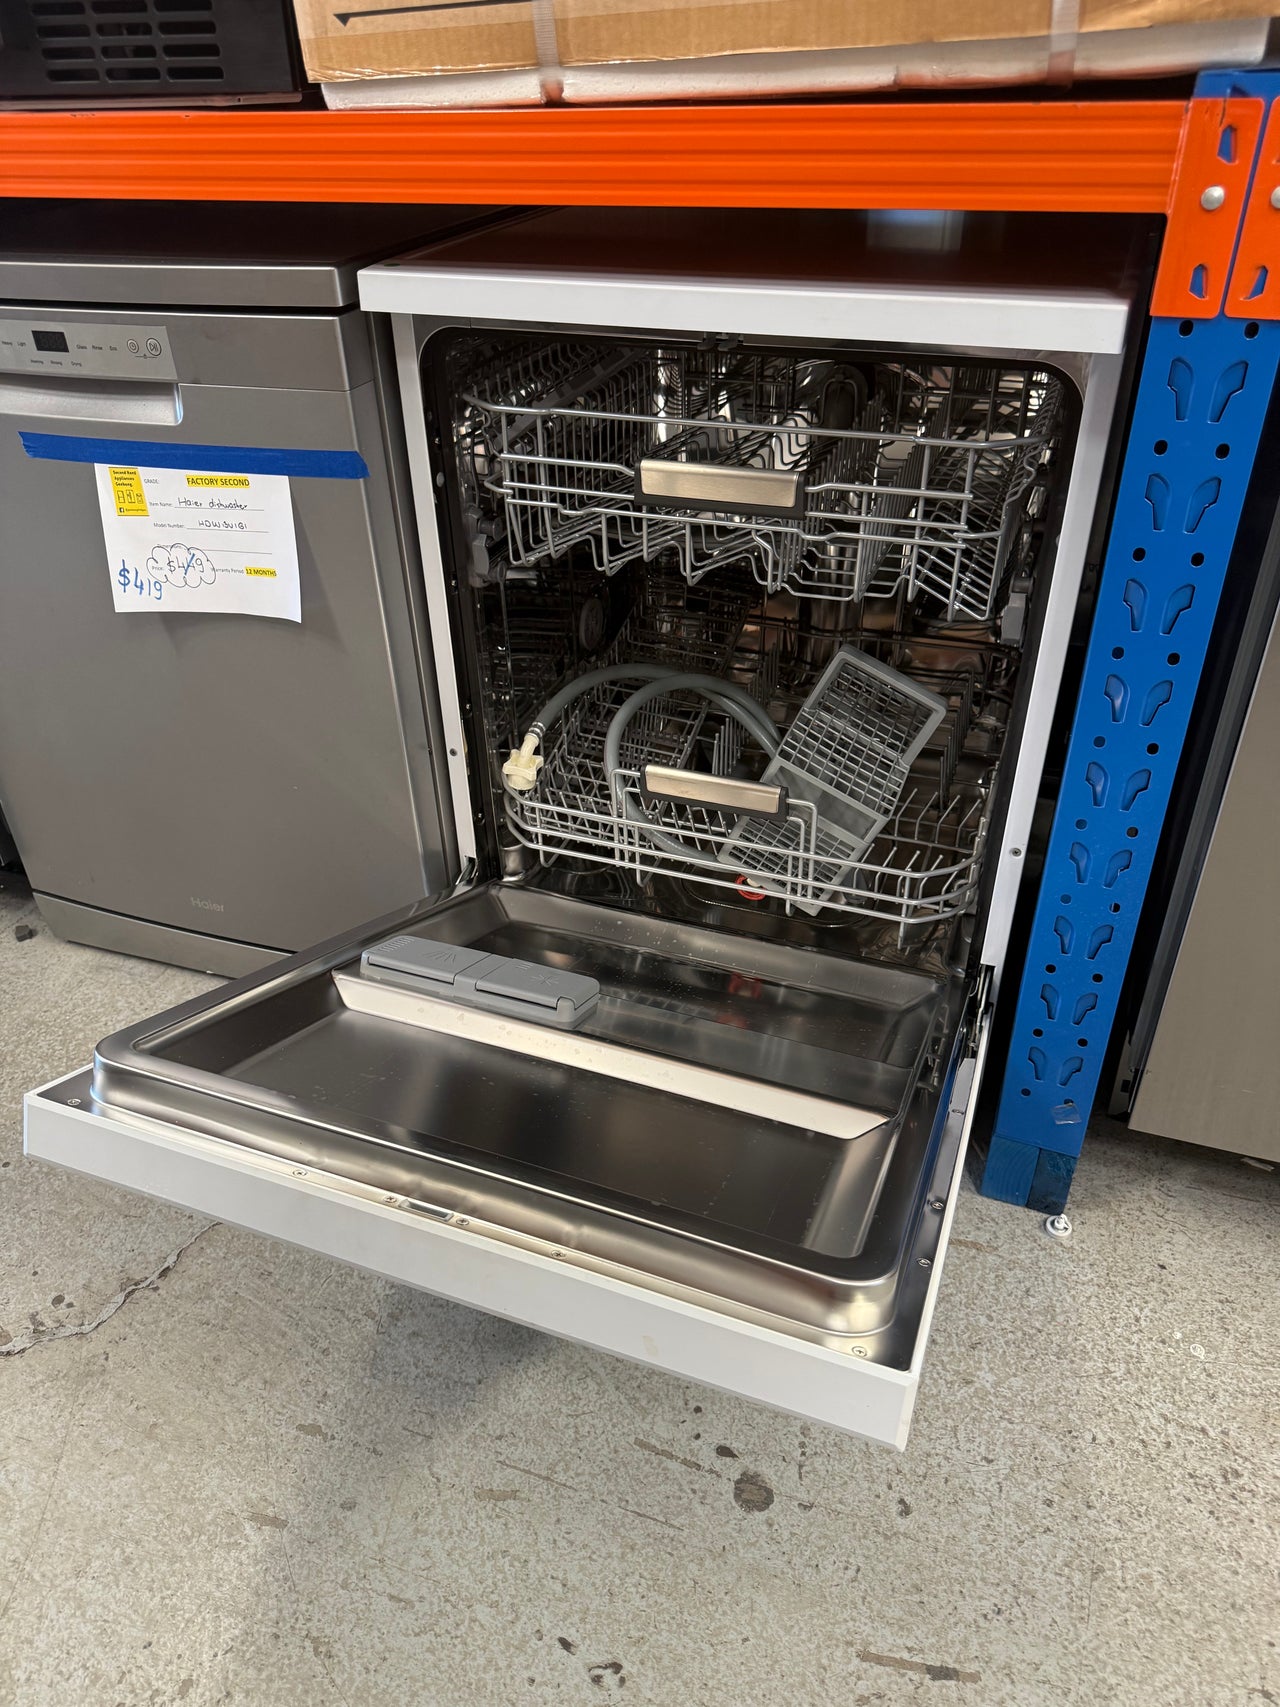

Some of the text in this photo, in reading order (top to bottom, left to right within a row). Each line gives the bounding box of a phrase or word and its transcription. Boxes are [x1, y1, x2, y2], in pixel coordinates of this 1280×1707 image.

[186, 477, 250, 487] FACTORY SECOND
[178, 497, 202, 507] Haier
[253, 569, 277, 577] MONTHS
[117, 558, 163, 601] $419
[190, 896, 224, 912] Haier
